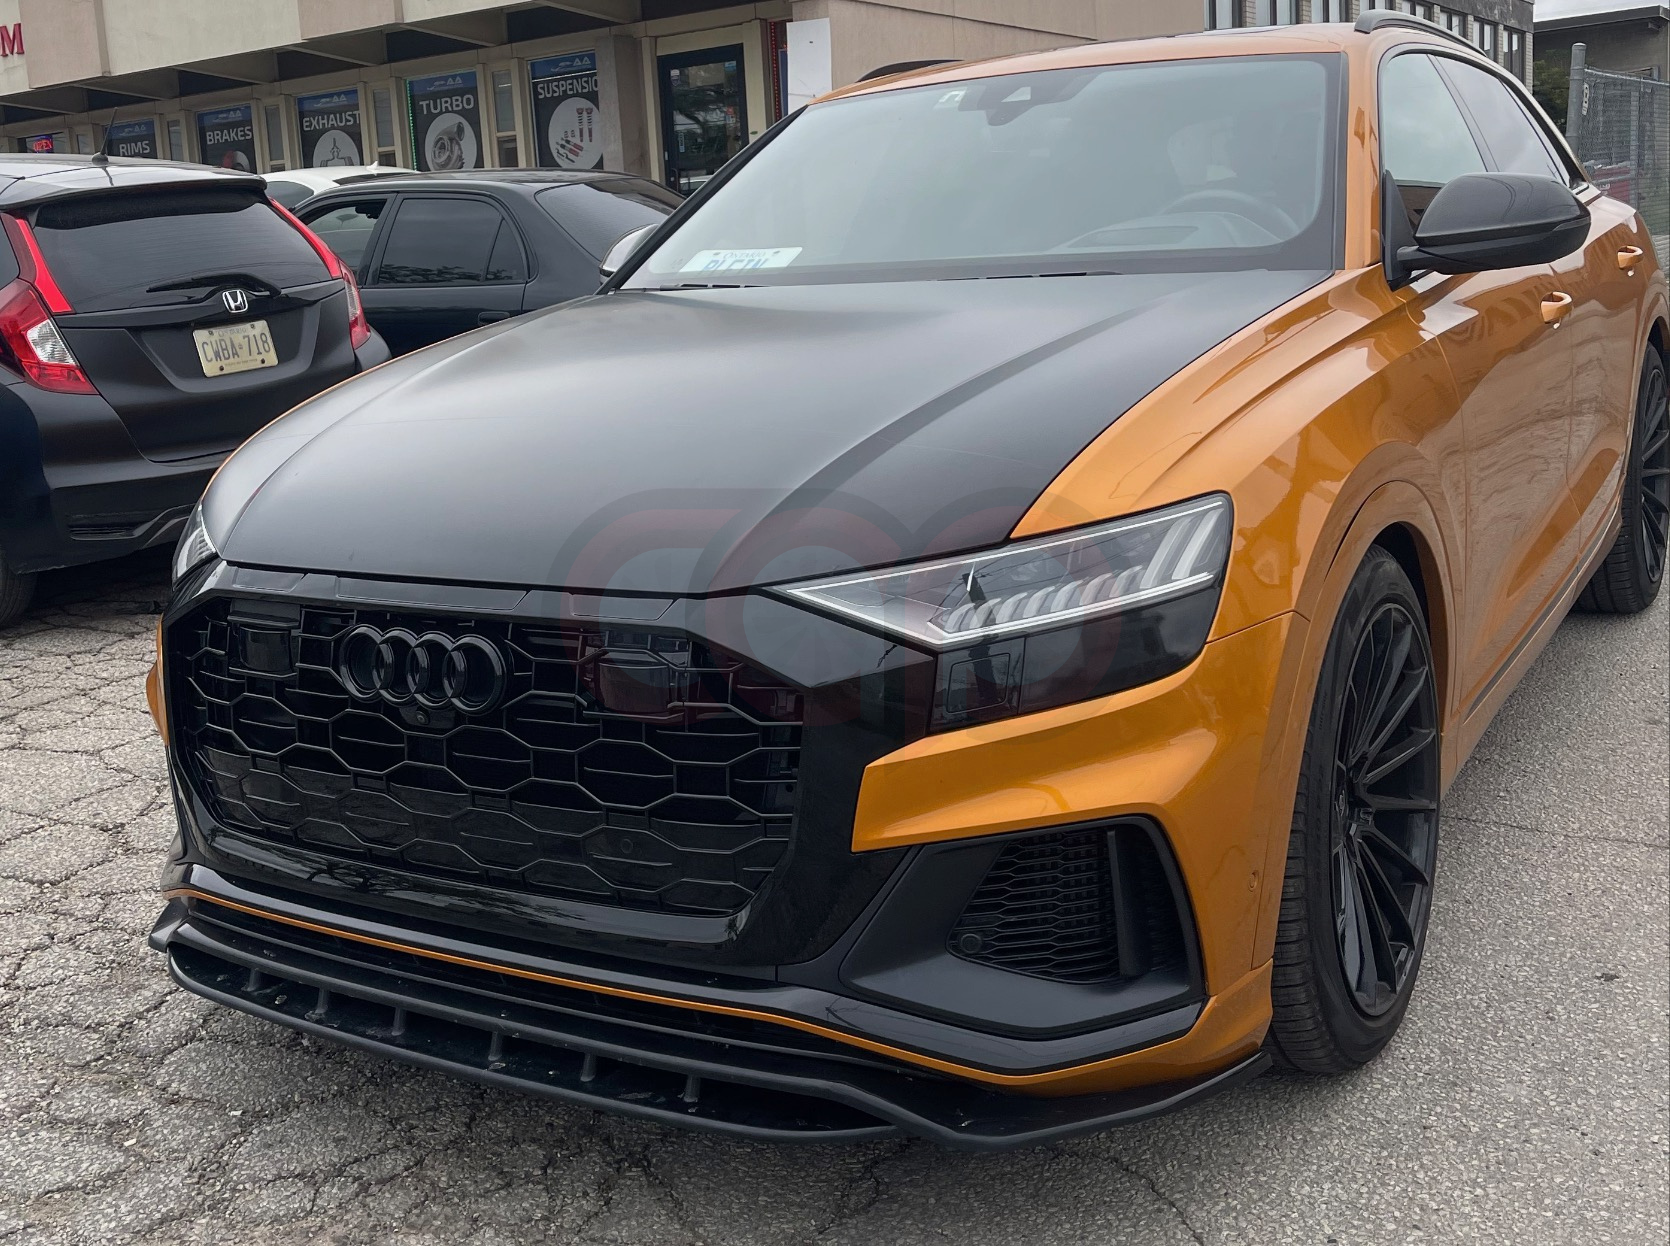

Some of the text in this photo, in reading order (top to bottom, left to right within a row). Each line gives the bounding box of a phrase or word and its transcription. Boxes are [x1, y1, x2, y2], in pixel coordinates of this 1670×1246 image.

[419, 94, 474, 115] TURBO
[302, 110, 361, 131] EXHAUST
[206, 126, 253, 145] BRAKES
[119, 140, 151, 157] RIMS
